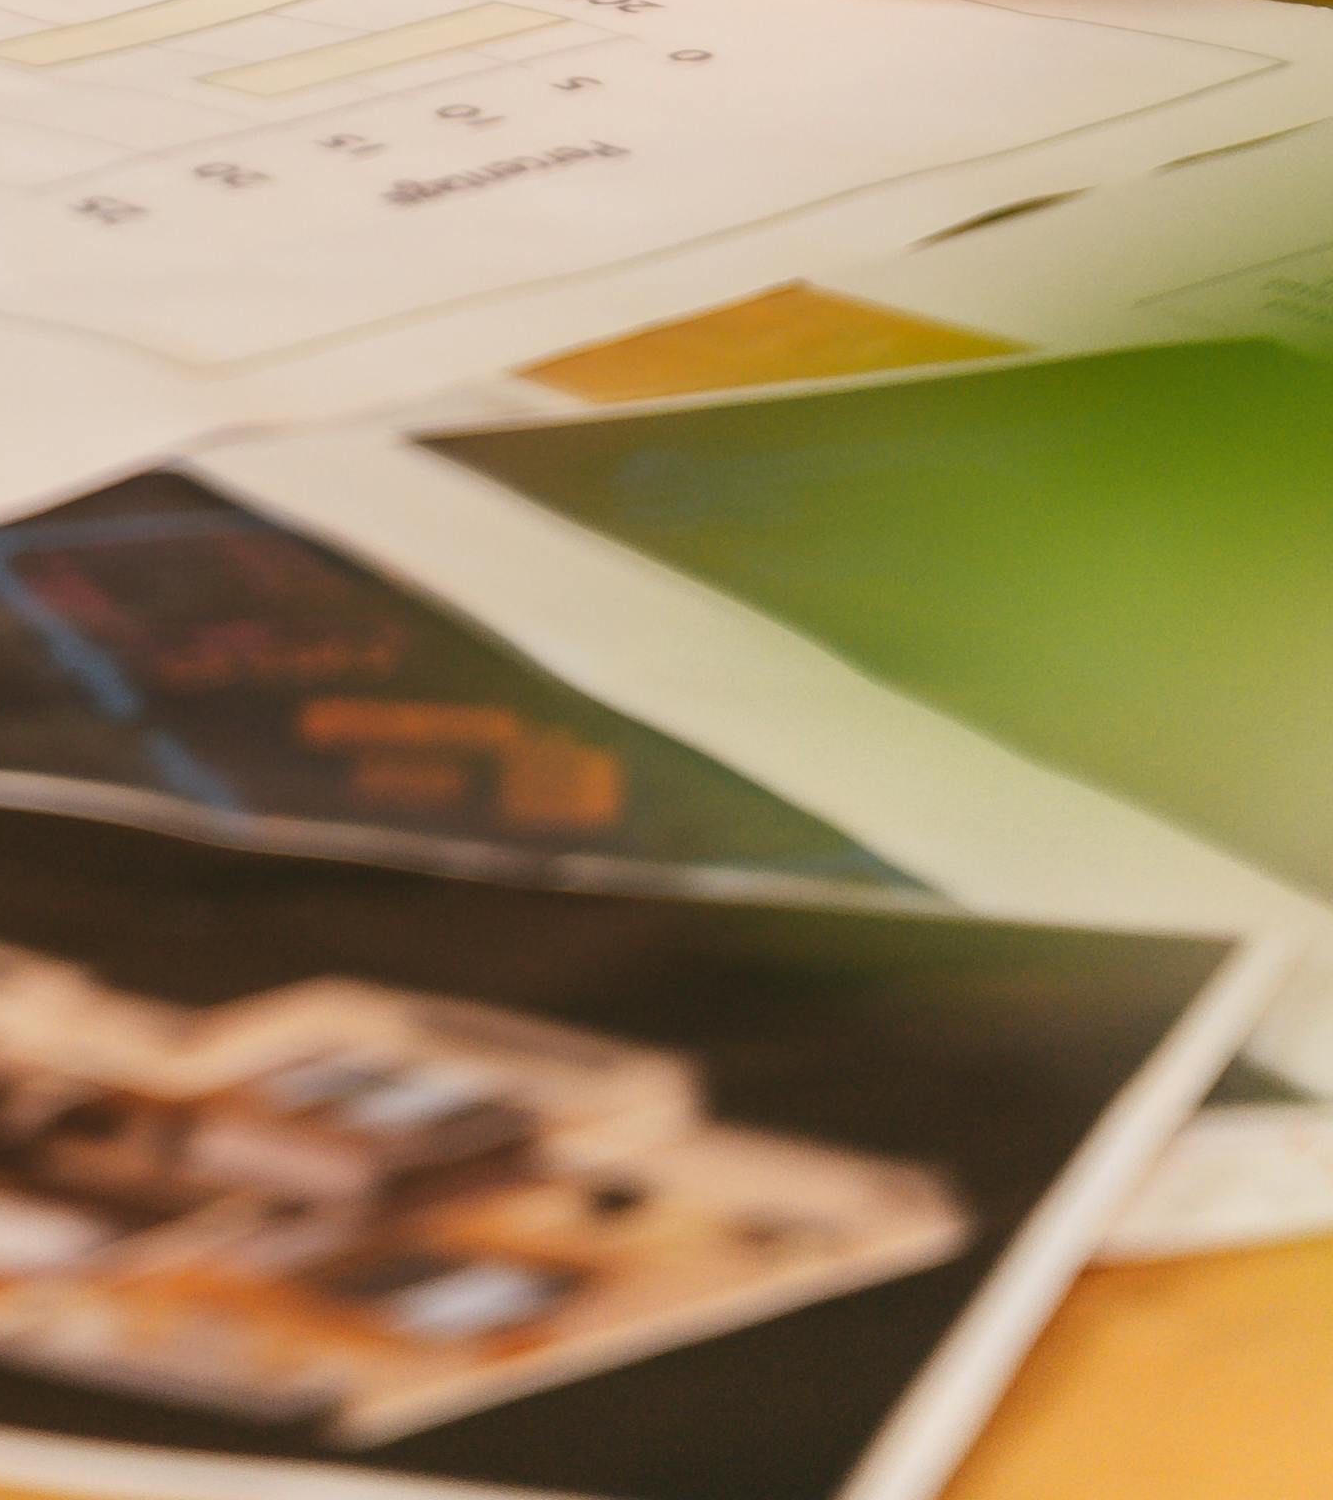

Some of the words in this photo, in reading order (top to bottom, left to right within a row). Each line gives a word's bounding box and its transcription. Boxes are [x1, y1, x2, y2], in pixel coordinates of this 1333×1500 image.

[666, 47, 713, 63] 0
[550, 73, 602, 93] 5
[434, 102, 505, 131] 10
[380, 138, 630, 209] Percentage
